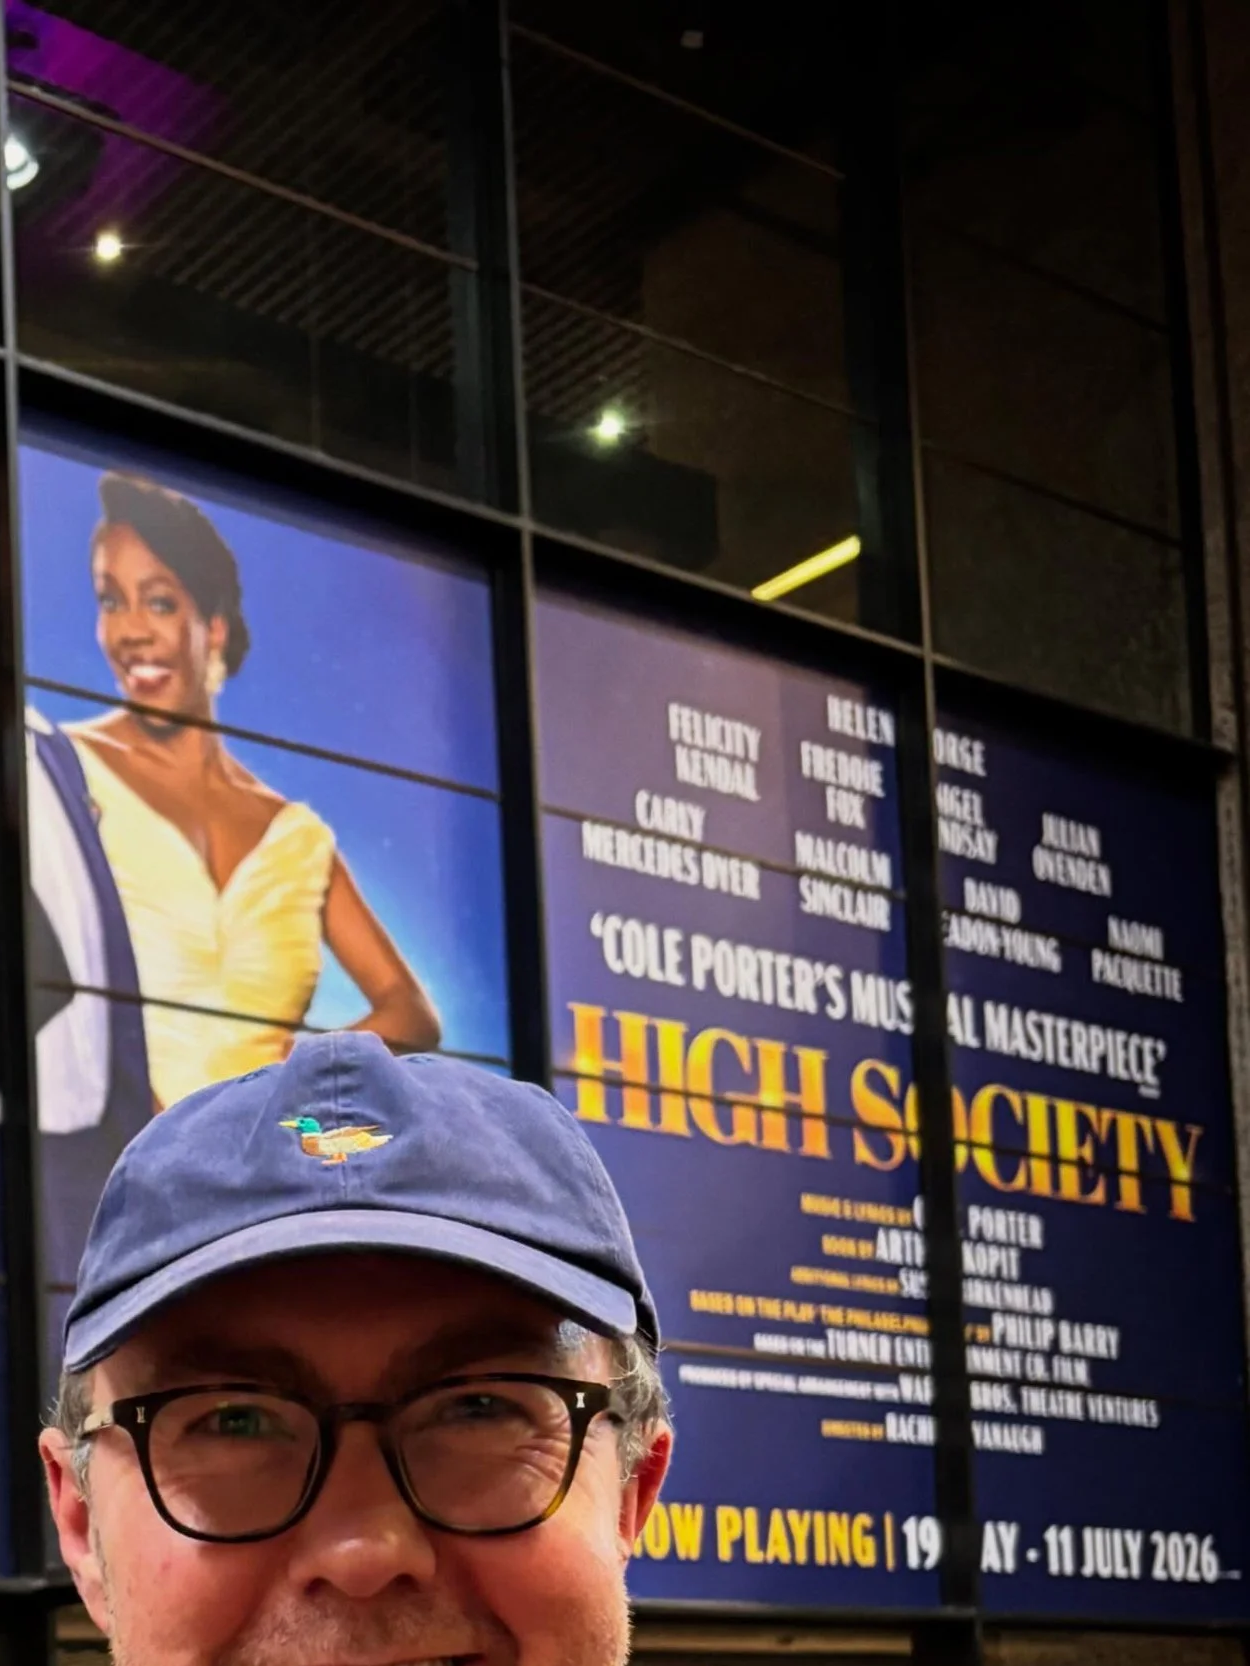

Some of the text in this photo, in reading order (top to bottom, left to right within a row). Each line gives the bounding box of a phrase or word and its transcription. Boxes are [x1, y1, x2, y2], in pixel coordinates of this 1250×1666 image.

[668, 702, 761, 762] FELICITY
[827, 694, 987, 777] HELEN ORGE
[675, 744, 761, 801] KENDAL
[800, 740, 885, 798] FREDDIE
[636, 789, 705, 841] CARLY
[826, 785, 865, 829] FOX
[582, 821, 761, 900] MERCEDES DYER
[795, 830, 892, 888] MALCOLM
[937, 816, 998, 865] NDSAY
[1042, 812, 1101, 858] JULIAN
[1032, 845, 1111, 897] OVENDEN
[800, 876, 892, 932] SINCLAIR
[963, 877, 1021, 924] DAVID
[1108, 914, 1164, 960] NAOMI
[851, 970, 980, 1048] MUSAL
[566, 1002, 833, 1161] HIGH
[968, 1204, 1043, 1249] PORTER
[962, 1239, 1020, 1281] KOPIT
[826, 1328, 892, 1366] TURNER
[992, 1311, 1054, 1351] PHILIP
[1058, 1319, 1119, 1360] BARRY
[1020, 1385, 1085, 1421] THEATRE
[1087, 1393, 1161, 1428] VENTURES
[971, 1419, 1044, 1455] VANAUGH
[716, 1505, 876, 1568] PLAYING
[902, 1515, 942, 1571] 19
[979, 1519, 1020, 1575] AY
[1043, 1523, 1075, 1577] 11
[1080, 1526, 1143, 1580] JULY
[1150, 1530, 1220, 1585] 2026
